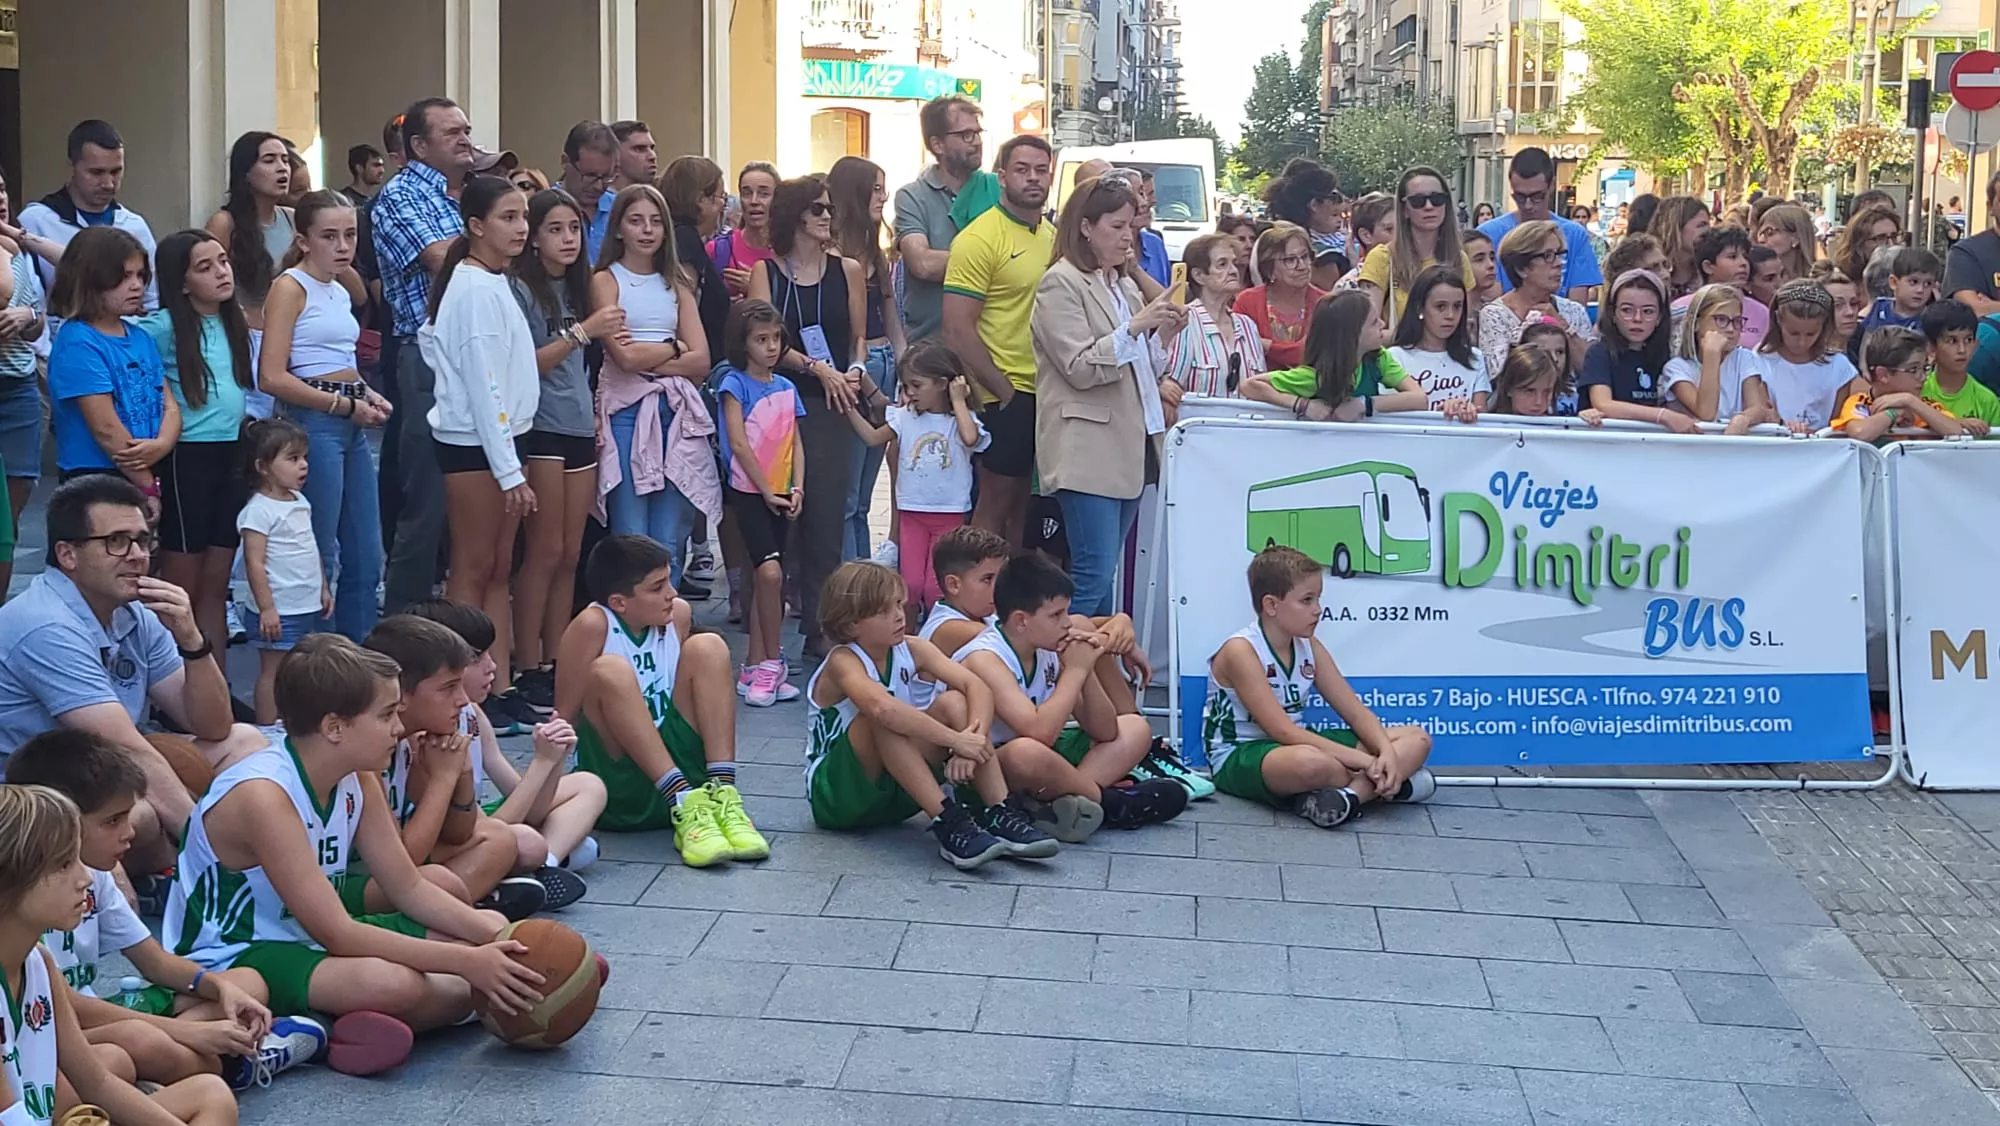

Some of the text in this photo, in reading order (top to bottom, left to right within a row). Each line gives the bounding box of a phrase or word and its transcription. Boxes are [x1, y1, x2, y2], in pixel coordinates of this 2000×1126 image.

[1526, 144, 1589, 159] NGO
[1489, 471, 1599, 528] Viajes
[1441, 491, 1692, 606] Dimitri
[1368, 606, 1409, 621] 0332
[1414, 606, 1449, 621] Mm
[1643, 597, 1784, 656] BUS S.L.
[1930, 630, 2000, 680] M
[1283, 684, 1300, 704] 16
[1431, 689, 1444, 706] 7
[1448, 688, 1493, 711] Bajo
[1507, 687, 1588, 706] HUESCA
[1600, 686, 1656, 705] Tlfno.
[1660, 686, 1698, 705] 974
[1702, 686, 1737, 704] 221
[1743, 686, 1780, 704] 910
[1531, 714, 1793, 738] info@viajesdimitribus.com
